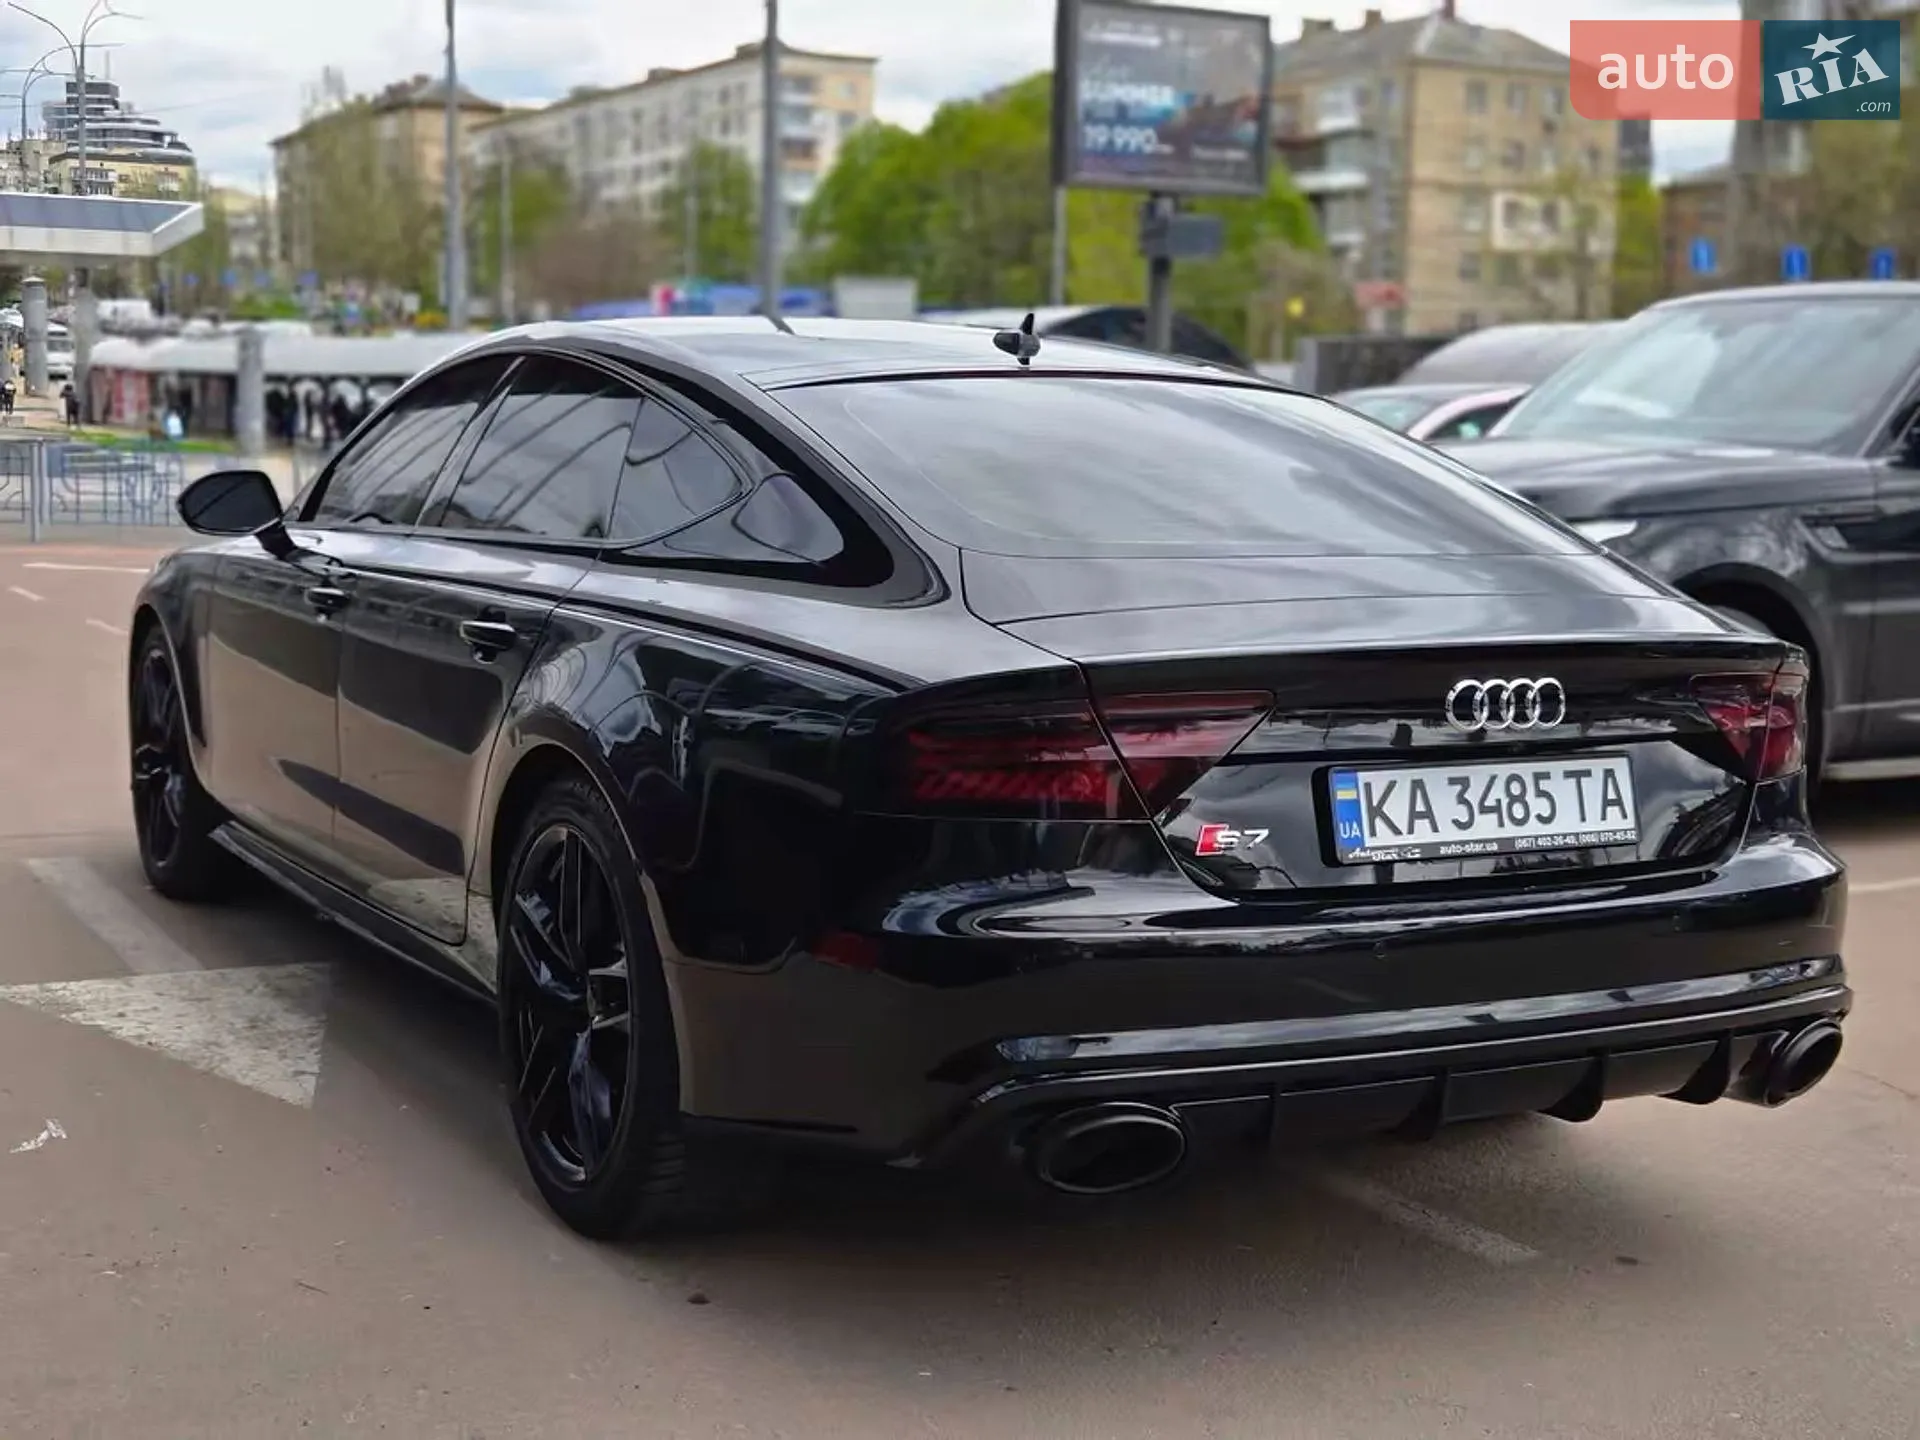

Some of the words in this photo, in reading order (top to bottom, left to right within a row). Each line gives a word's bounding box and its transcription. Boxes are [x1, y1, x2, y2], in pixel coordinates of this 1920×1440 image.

[1363, 778, 1440, 838] KA
[1447, 771, 1558, 831] 3485
[1563, 767, 1629, 823] TA
[1213, 828, 1269, 849] S7
[1340, 821, 1361, 839] UA
